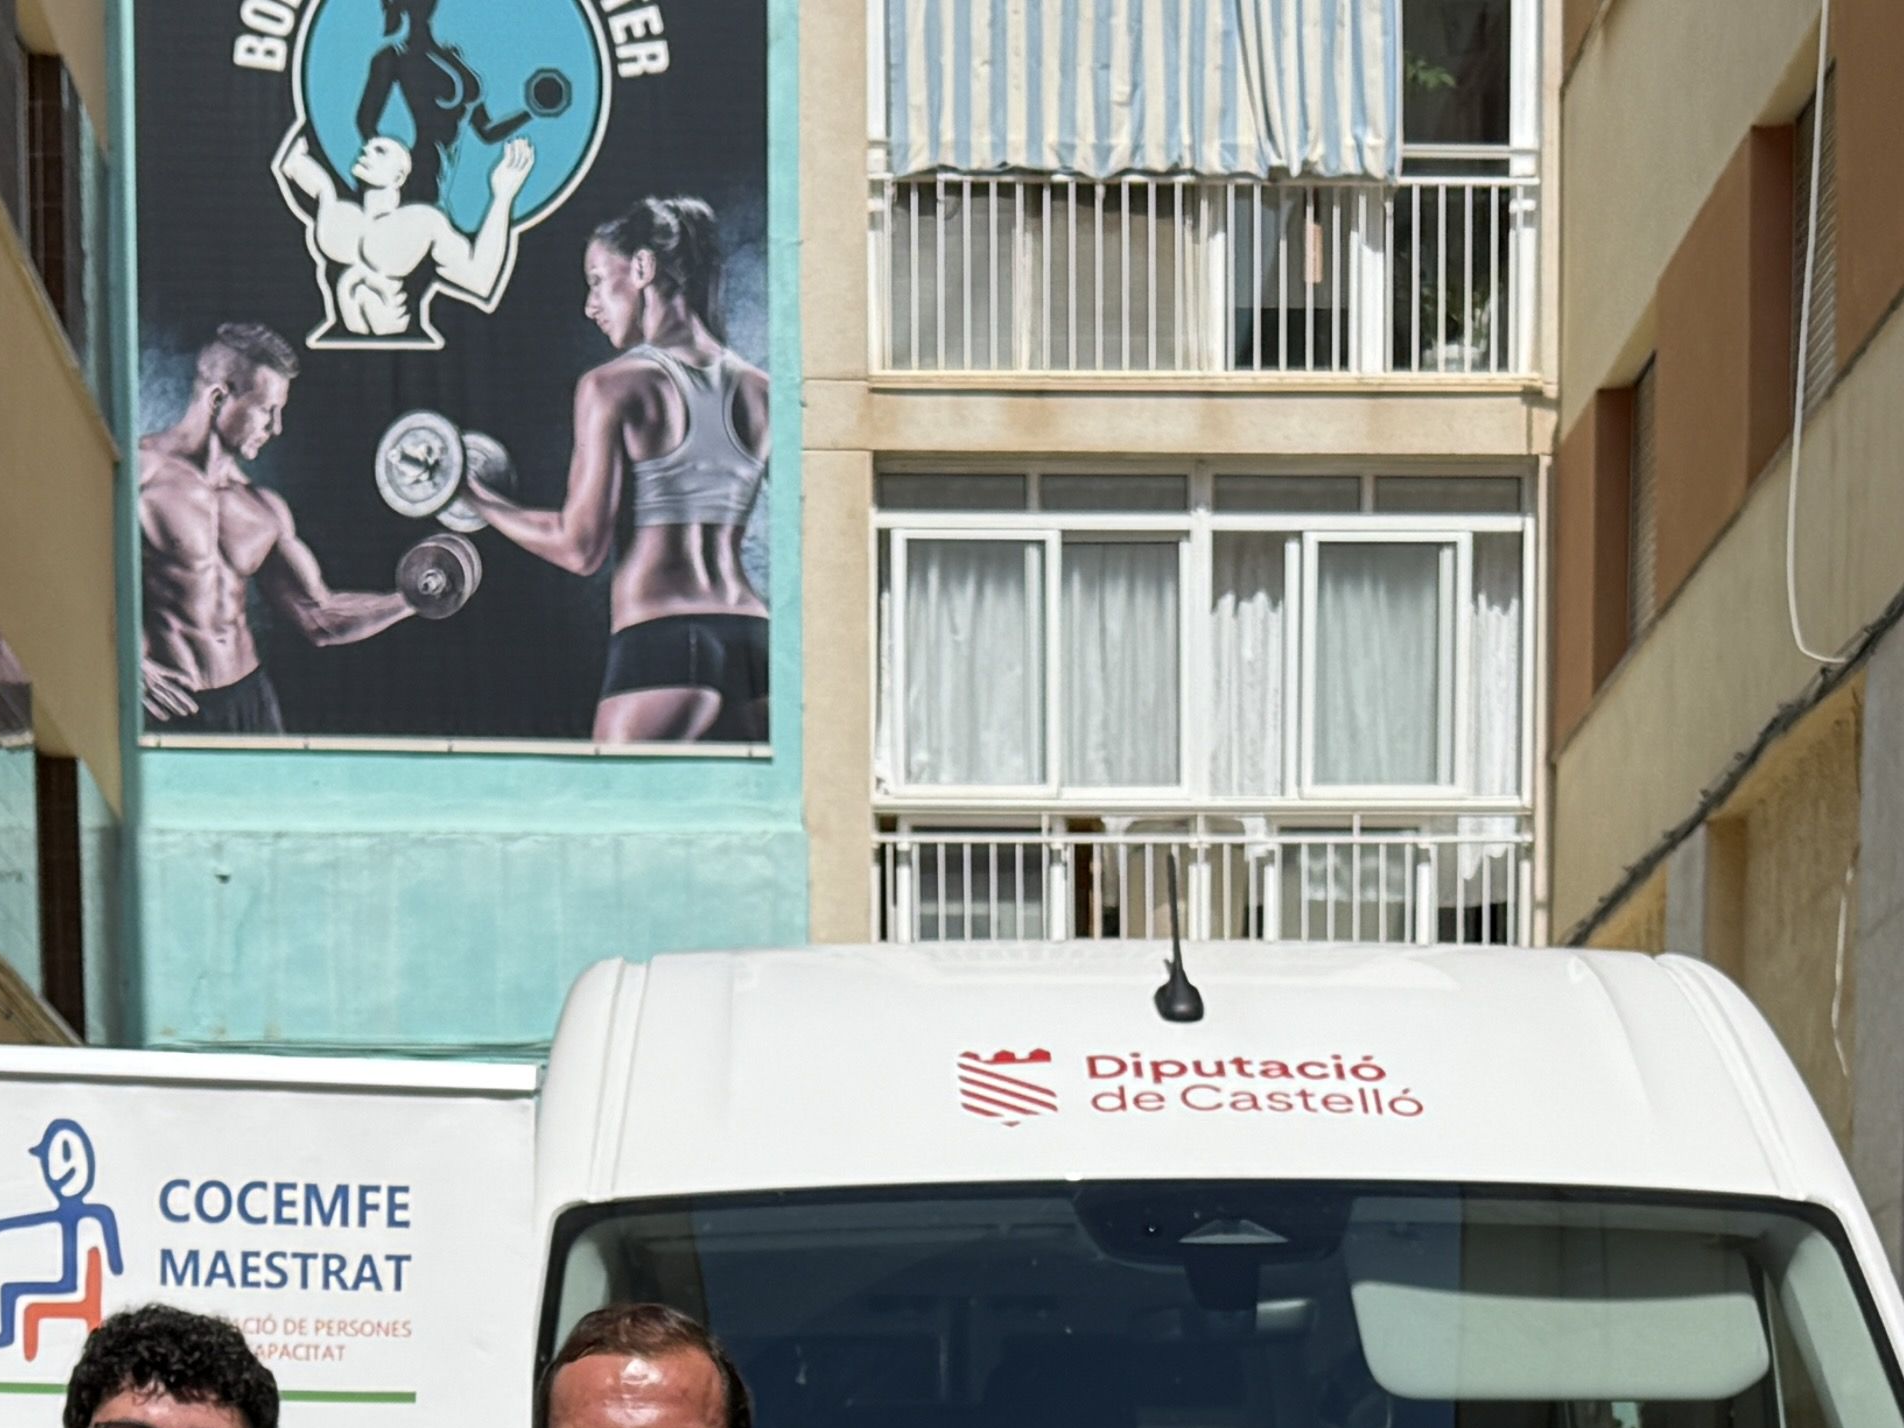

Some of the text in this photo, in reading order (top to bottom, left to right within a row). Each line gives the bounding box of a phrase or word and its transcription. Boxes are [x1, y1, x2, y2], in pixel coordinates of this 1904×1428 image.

[233, 0, 302, 72] BO
[1086, 1052, 1386, 1084] Diputació
[1091, 1084, 1424, 1117] de Castelló
[158, 1178, 411, 1229] COCEMFE
[159, 1248, 412, 1292] MAESTRAT
[283, 1318, 307, 1336] DE
[314, 1319, 412, 1338] PERSONES
